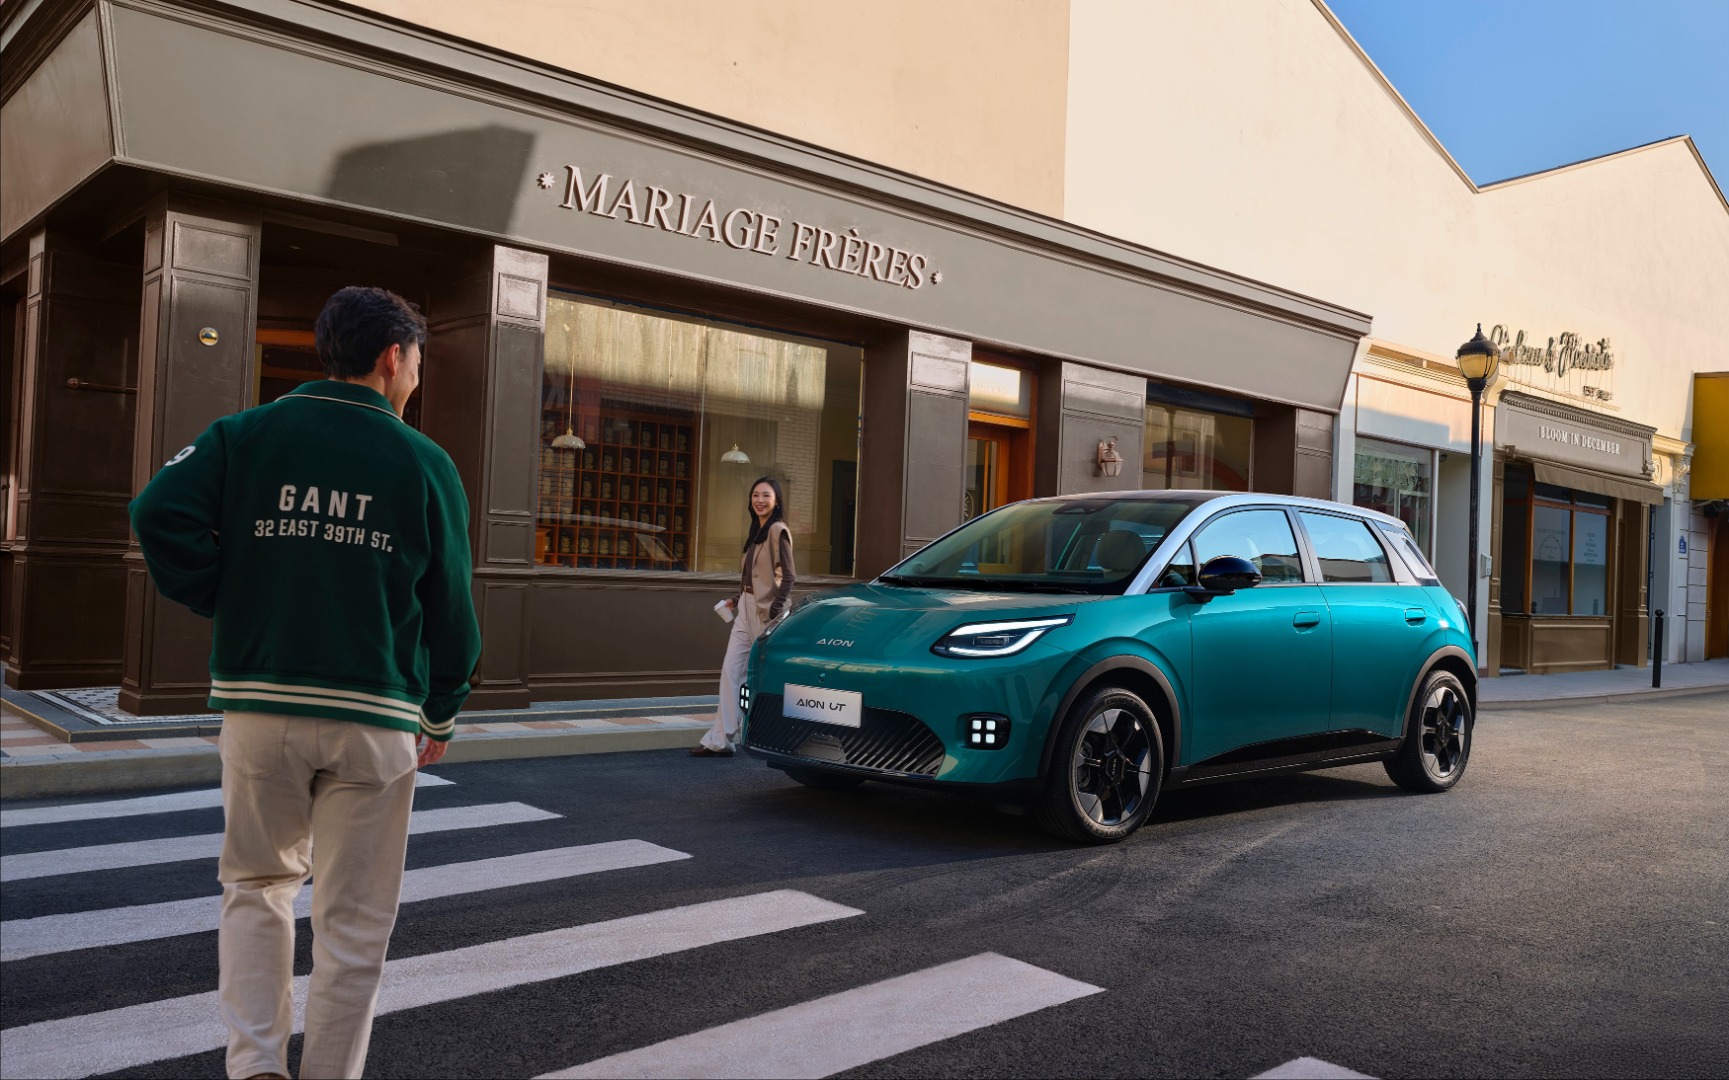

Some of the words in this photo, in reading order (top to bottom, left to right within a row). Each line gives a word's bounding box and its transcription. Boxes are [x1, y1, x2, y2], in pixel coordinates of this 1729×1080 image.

[559, 165, 783, 256] MARIAGE
[787, 221, 929, 290] FRÈRES
[1540, 425, 1568, 443] BLOOM
[1570, 432, 1579, 446] IN
[1581, 435, 1620, 454] DECEMBER
[278, 484, 373, 521] GANT
[254, 519, 275, 538] 32
[278, 518, 320, 538] EAST
[323, 522, 366, 545] 39TH
[370, 531, 393, 553] ST.
[816, 638, 854, 648] AION
[796, 698, 825, 710] AION
[829, 702, 846, 712] UT
